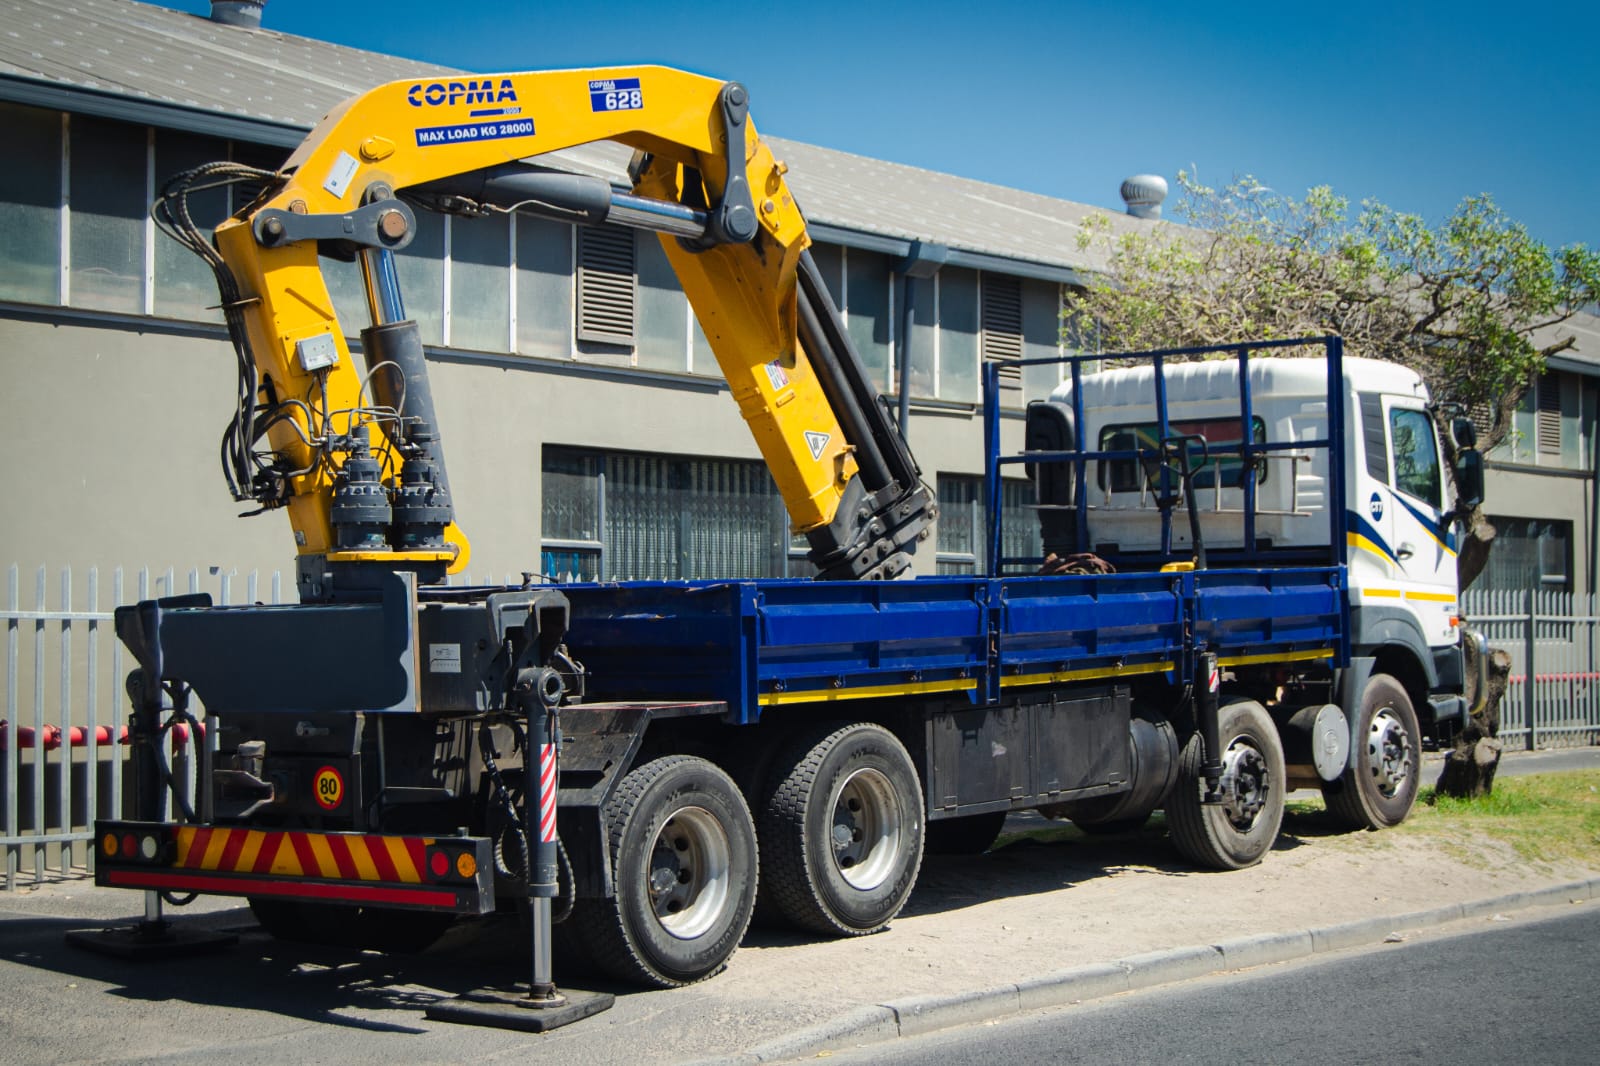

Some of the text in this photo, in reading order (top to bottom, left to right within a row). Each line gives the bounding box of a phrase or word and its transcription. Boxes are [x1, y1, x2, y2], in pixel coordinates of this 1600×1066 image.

[408, 80, 517, 107] COPMA
[590, 80, 616, 89] COPMA
[606, 91, 641, 110] 628
[419, 122, 532, 142] MAX LOAD KG 28000
[320, 778, 337, 795] 80
